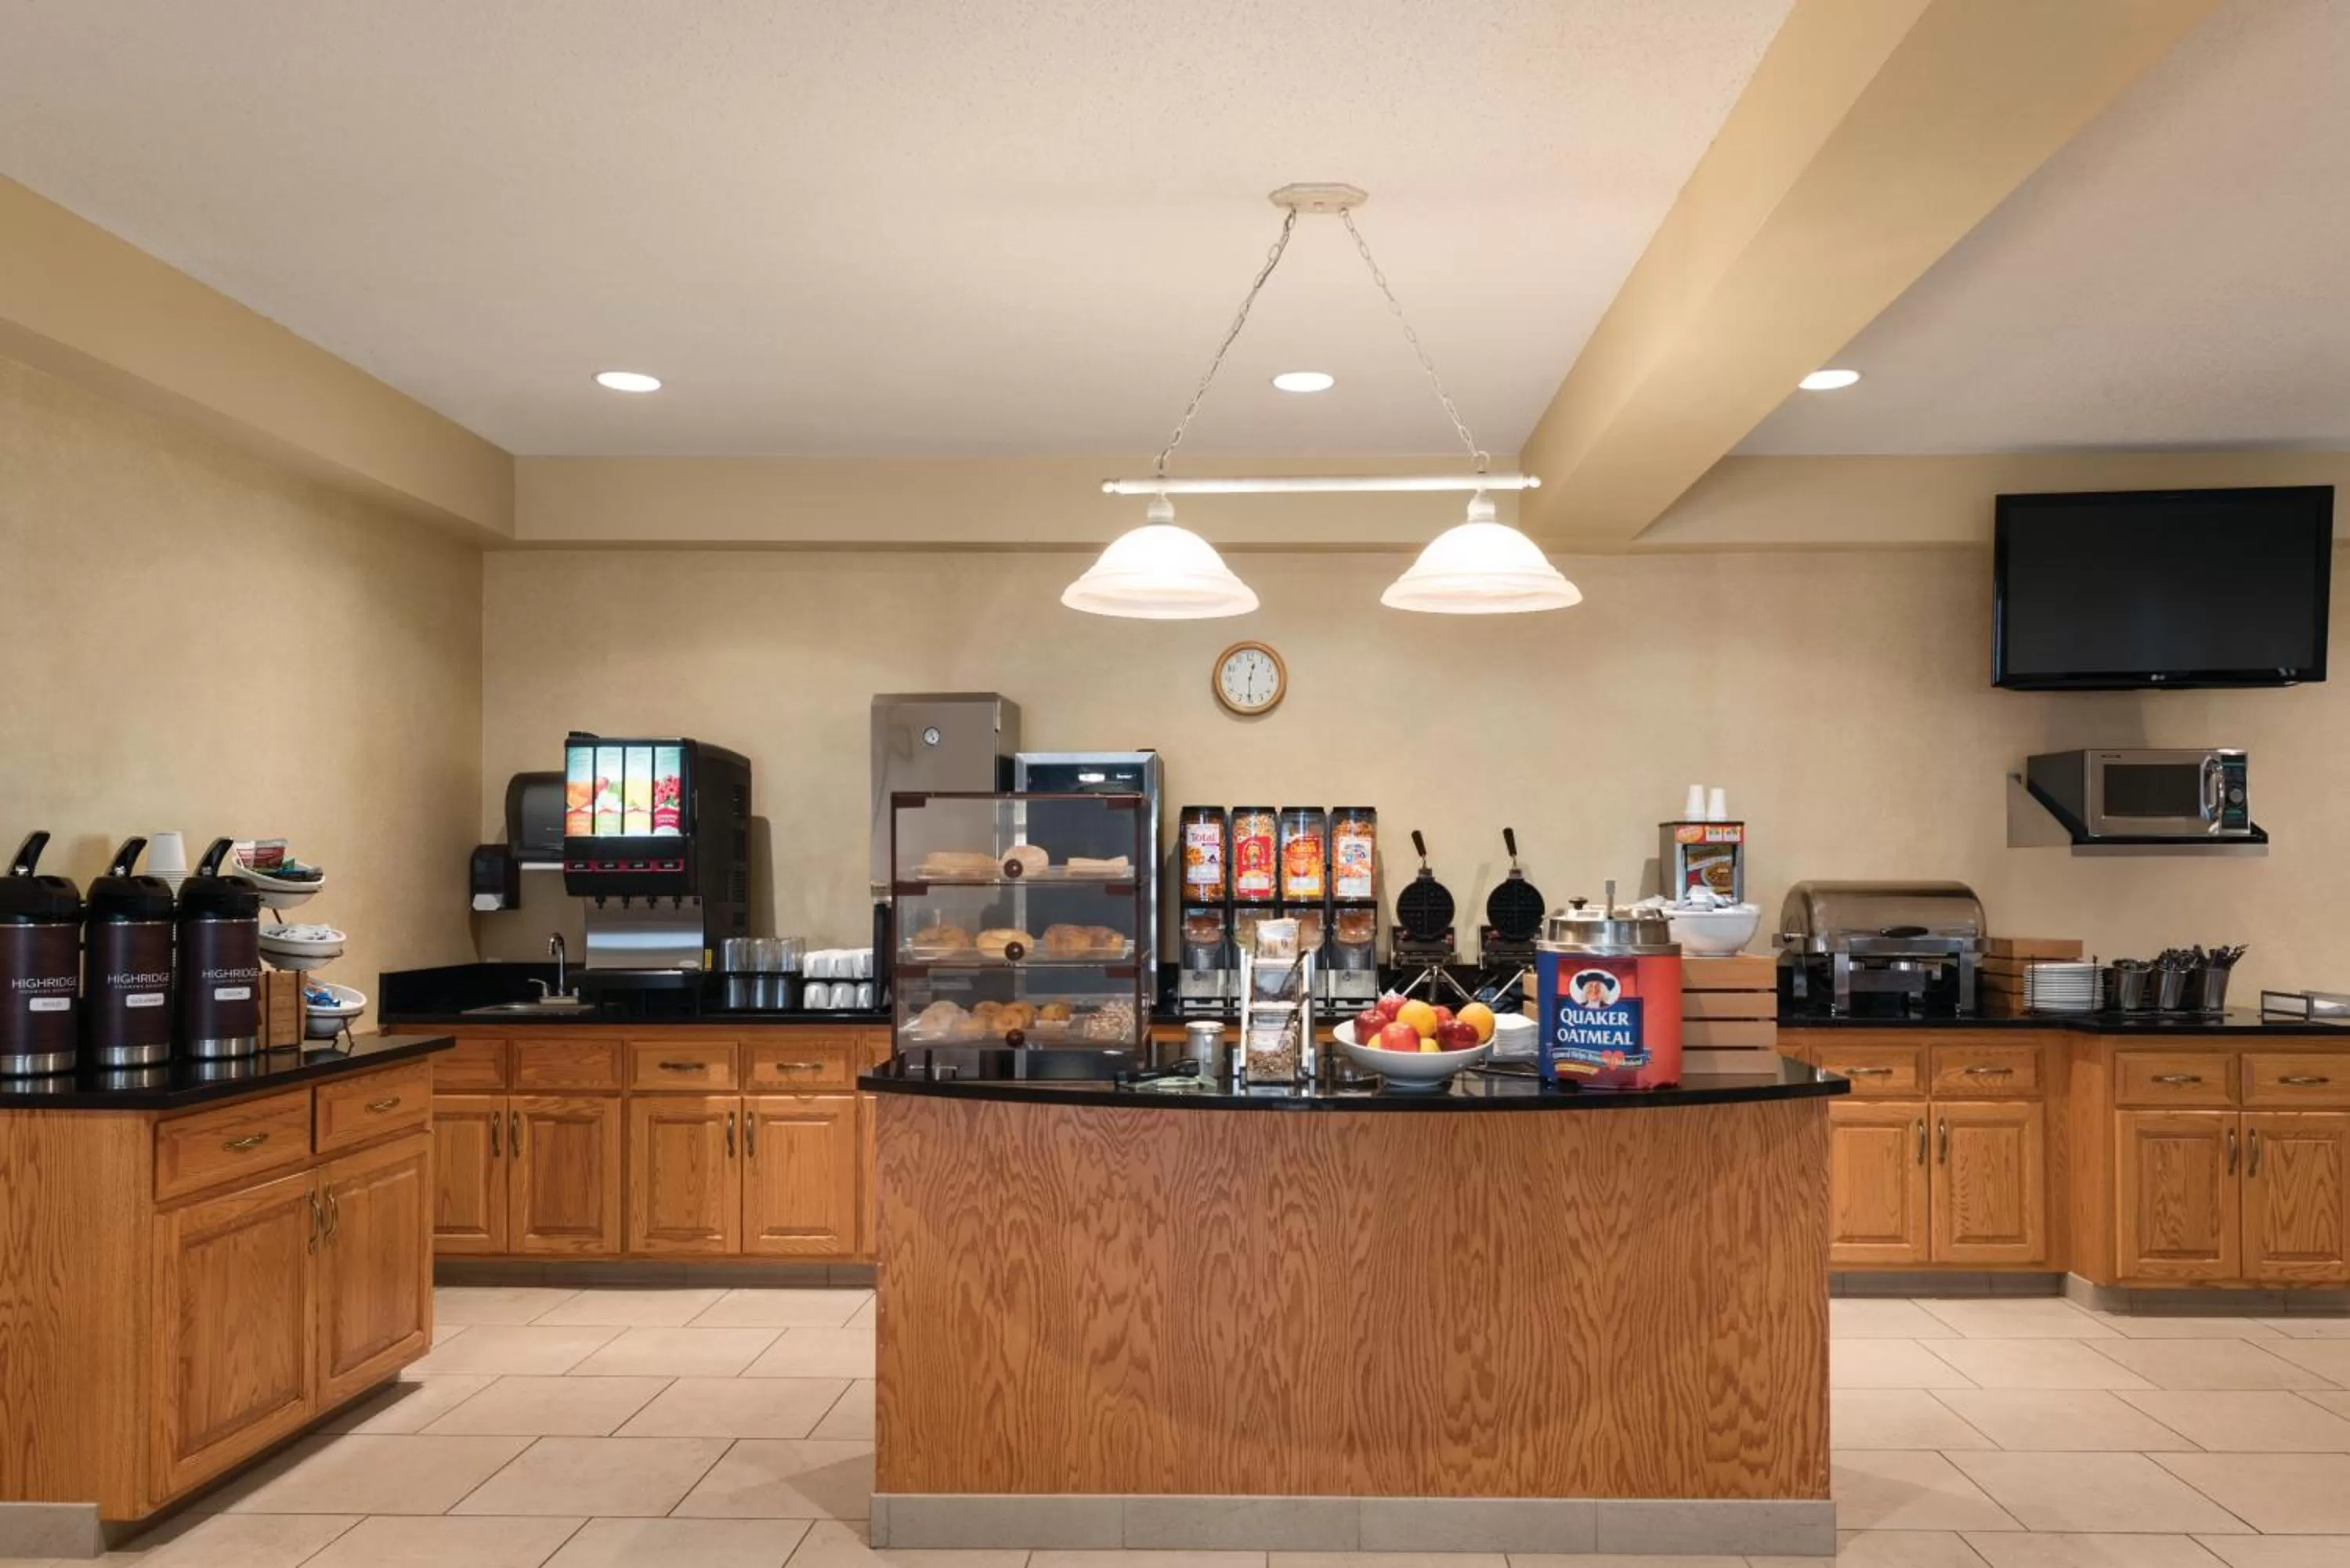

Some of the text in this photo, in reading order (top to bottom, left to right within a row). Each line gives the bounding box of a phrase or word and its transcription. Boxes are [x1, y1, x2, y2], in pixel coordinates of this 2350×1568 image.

[1191, 833, 1215, 842] Total
[107, 972, 170, 985] HIGHRIDGE
[201, 967, 258, 978] HIGHRIDGE
[12, 977, 77, 990] HIGHRIDGE
[1560, 1007, 1630, 1027] QUAKER
[1556, 1028, 1635, 1046] OATMEAL
